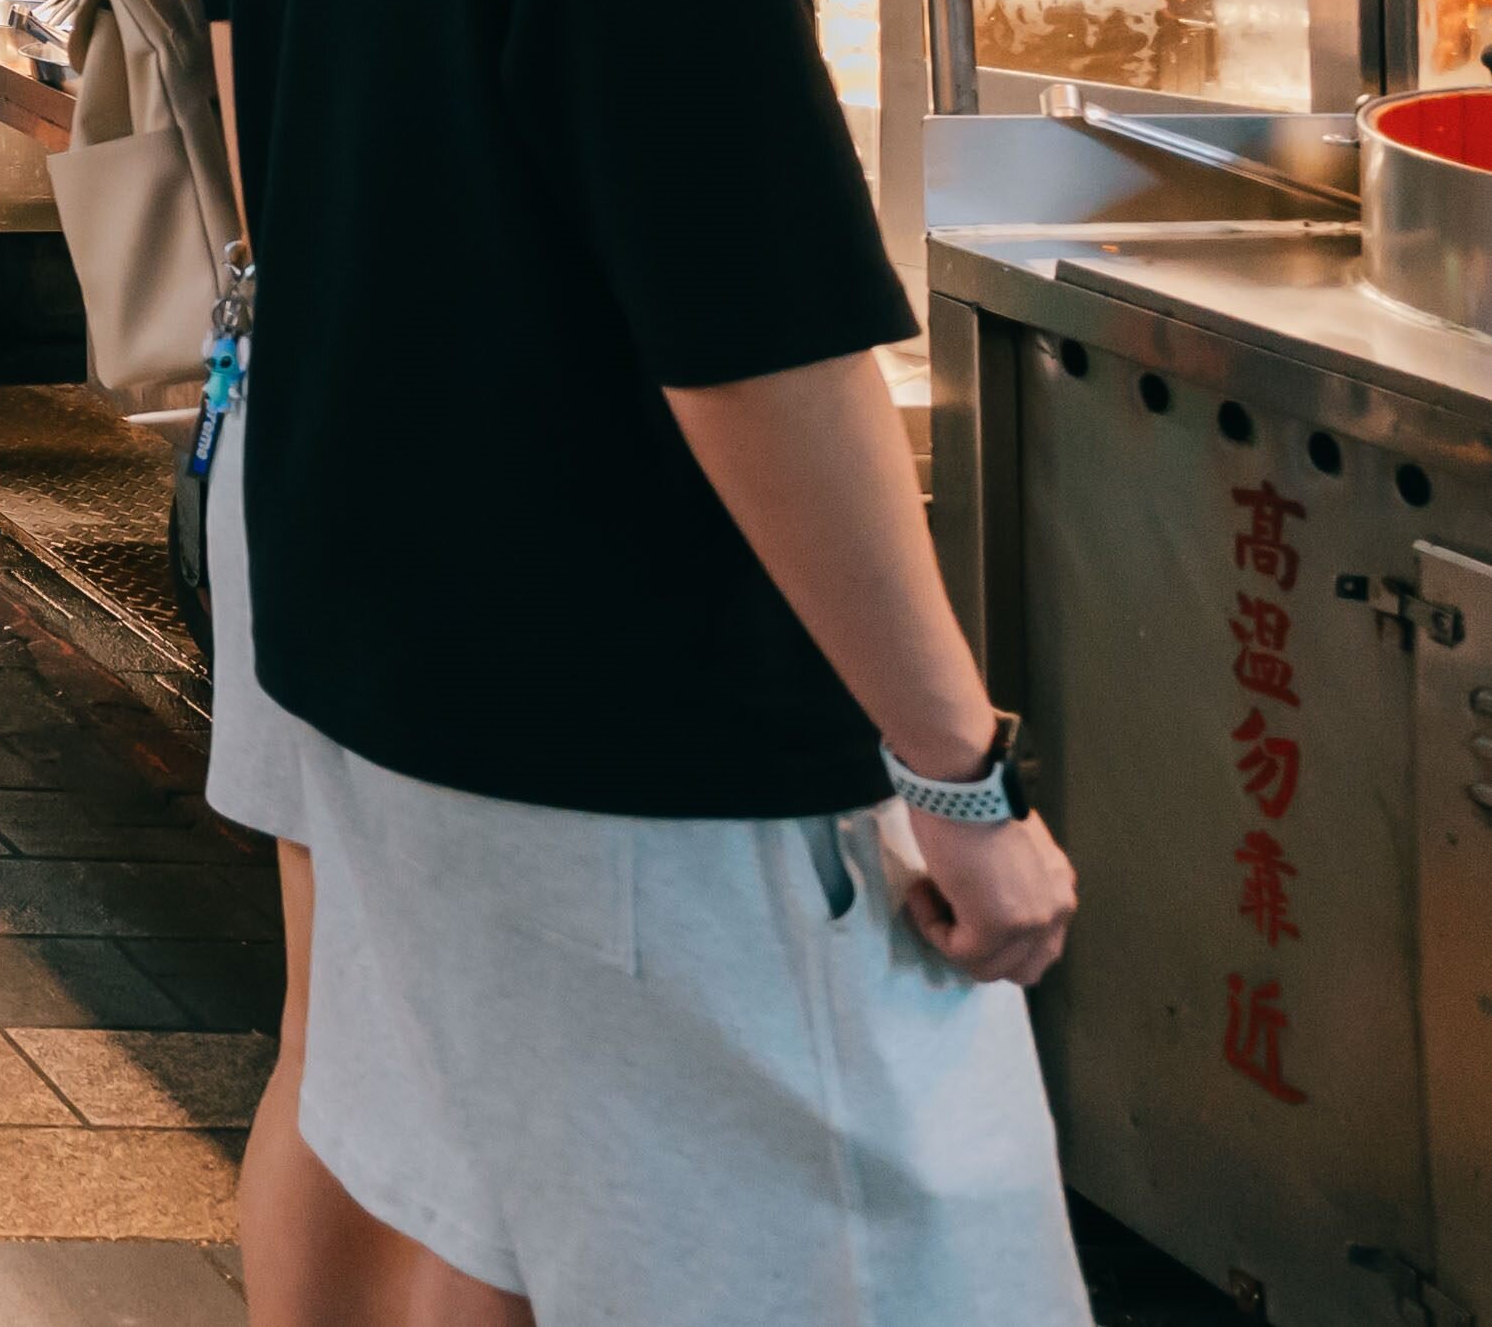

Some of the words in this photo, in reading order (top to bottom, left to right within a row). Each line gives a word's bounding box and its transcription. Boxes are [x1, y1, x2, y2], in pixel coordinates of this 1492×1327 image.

[1223, 479, 1309, 1107] 高溫勿靠近
